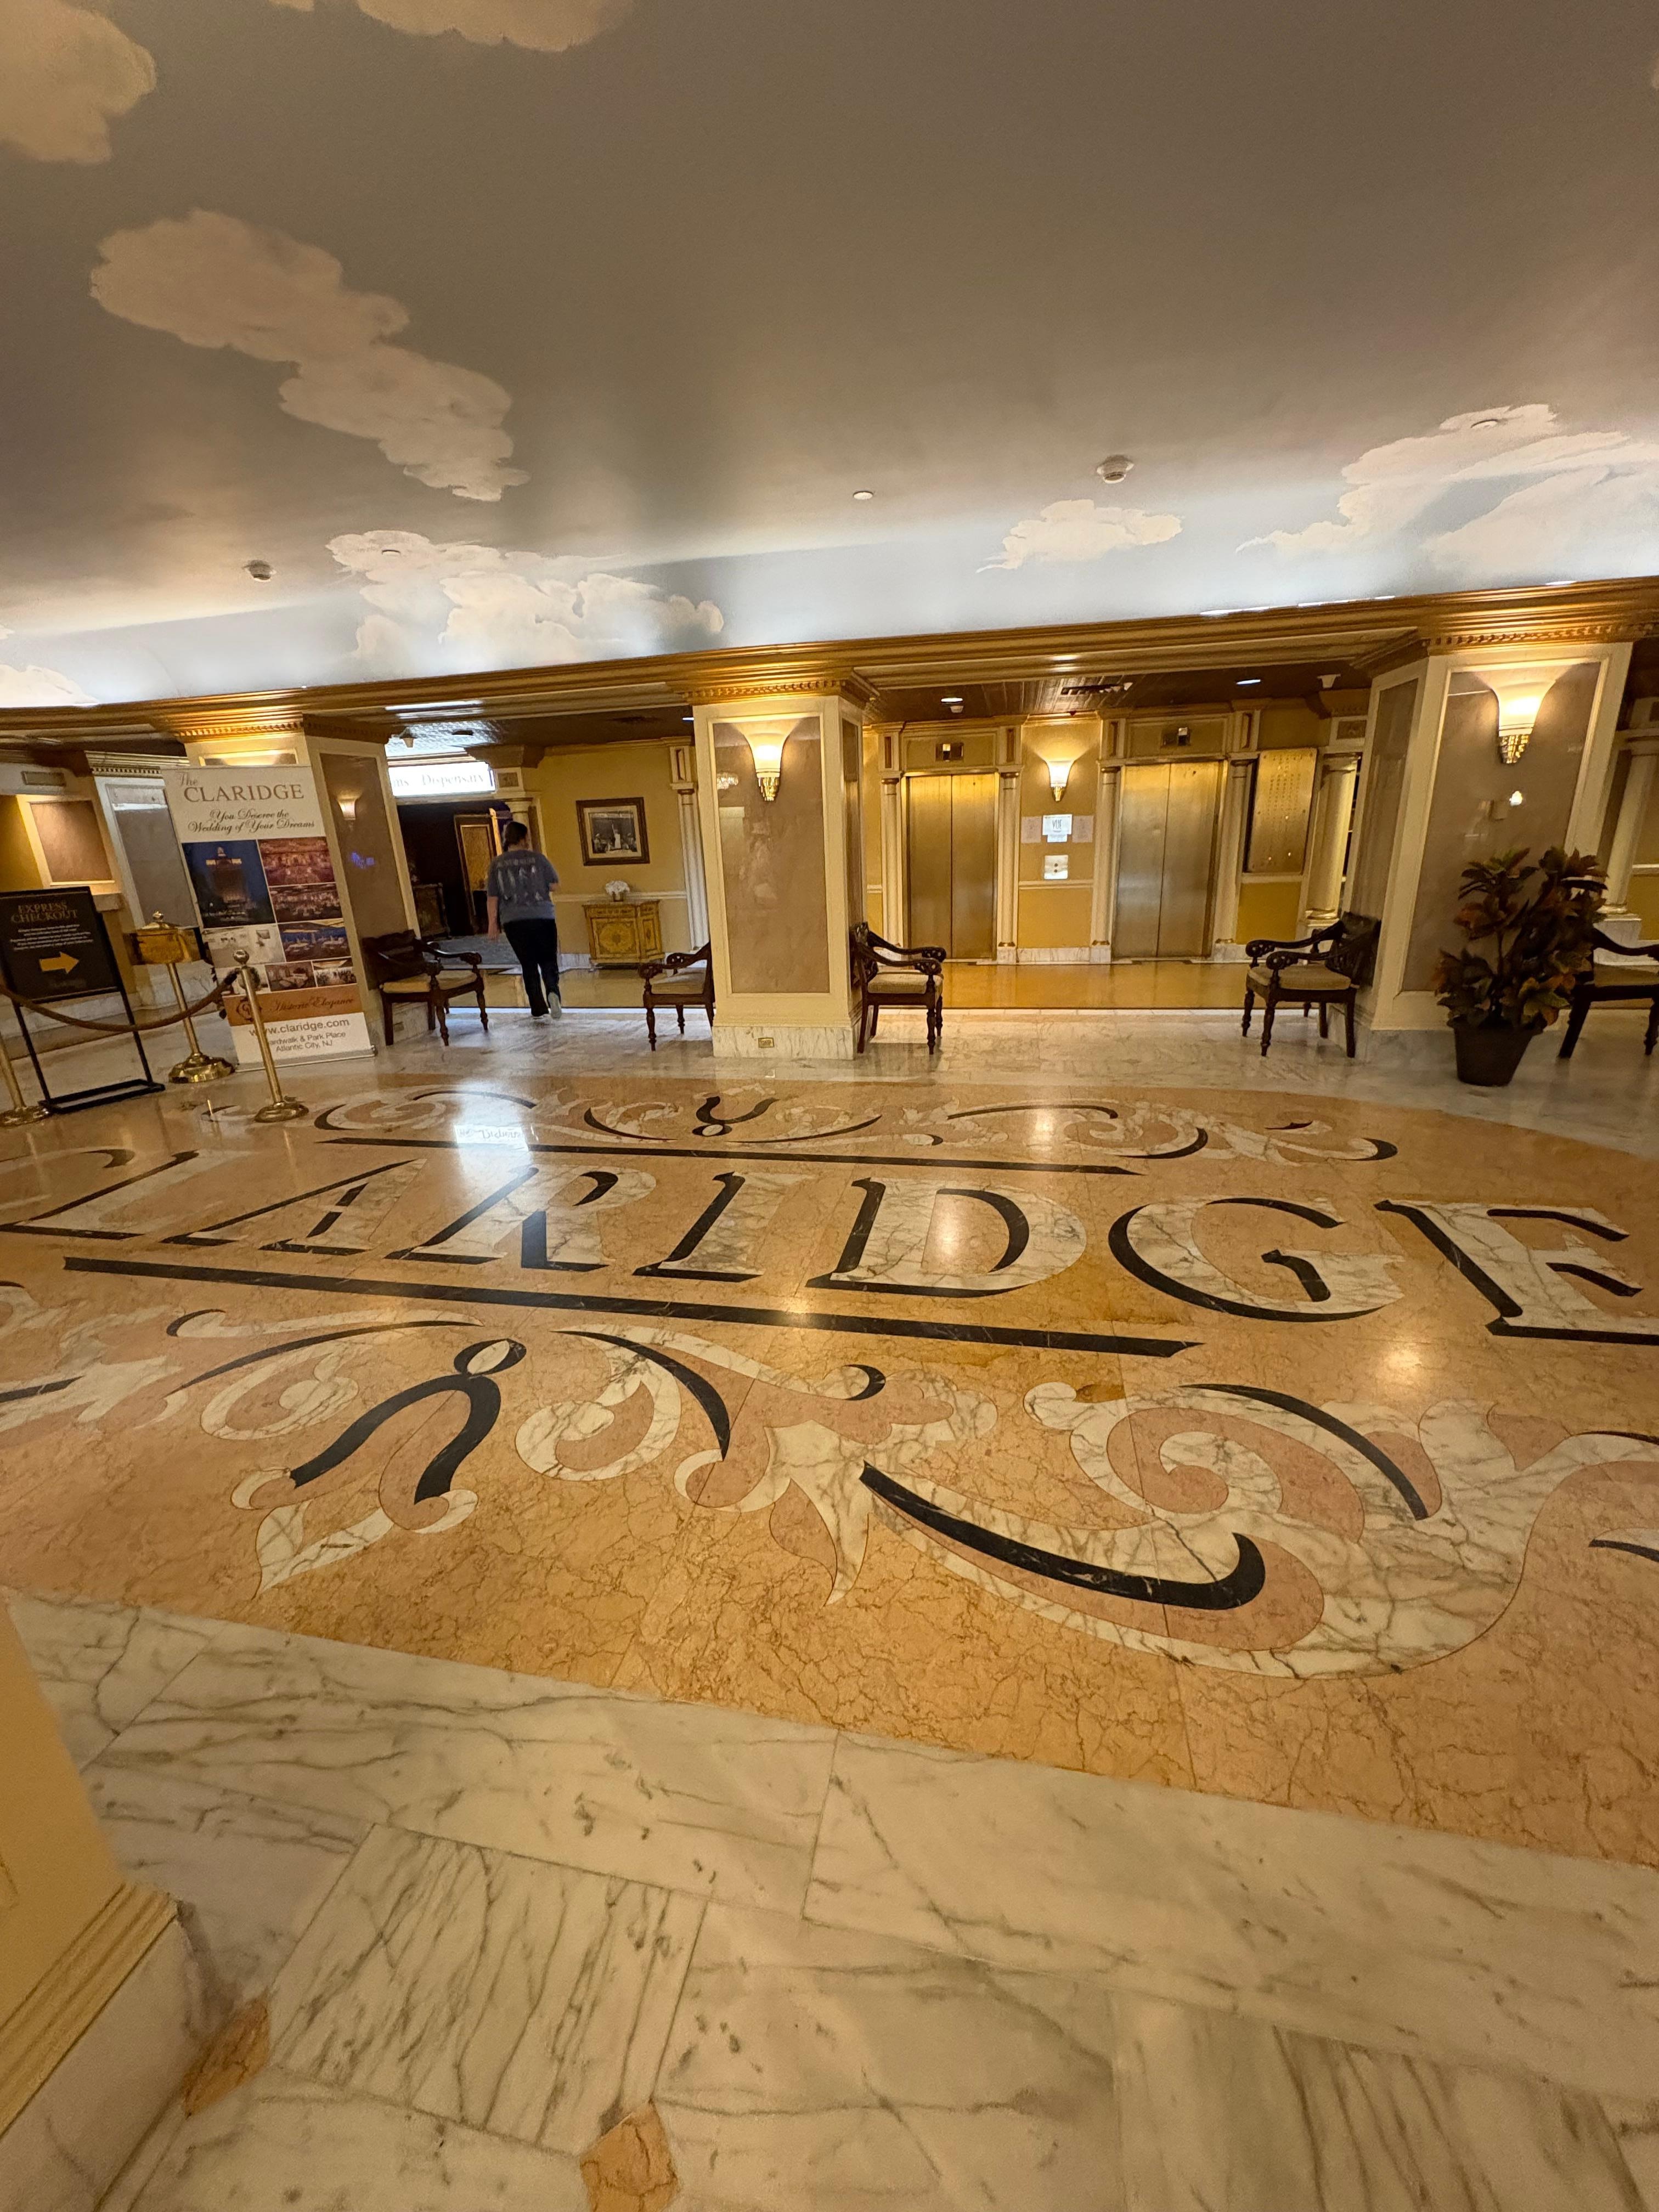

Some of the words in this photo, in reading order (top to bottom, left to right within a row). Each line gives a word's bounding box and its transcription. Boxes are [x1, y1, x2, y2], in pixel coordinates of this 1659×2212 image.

[178, 771, 198, 787] The
[184, 783, 304, 803] CLARIDGE
[210, 808, 235, 823] You
[237, 808, 275, 820] Deserve
[276, 809, 289, 818] the
[187, 820, 233, 834] Wedding
[233, 823, 244, 832] of
[245, 819, 274, 833] Your
[276, 817, 315, 830] Dreams
[18, 900, 68, 913] EXPRESS
[10, 909, 78, 923] CHECKOUT
[249, 1019, 350, 1037] ww.claridge.com
[325, 1031, 346, 1040] Place
[276, 1043, 303, 1052] Atlantic
